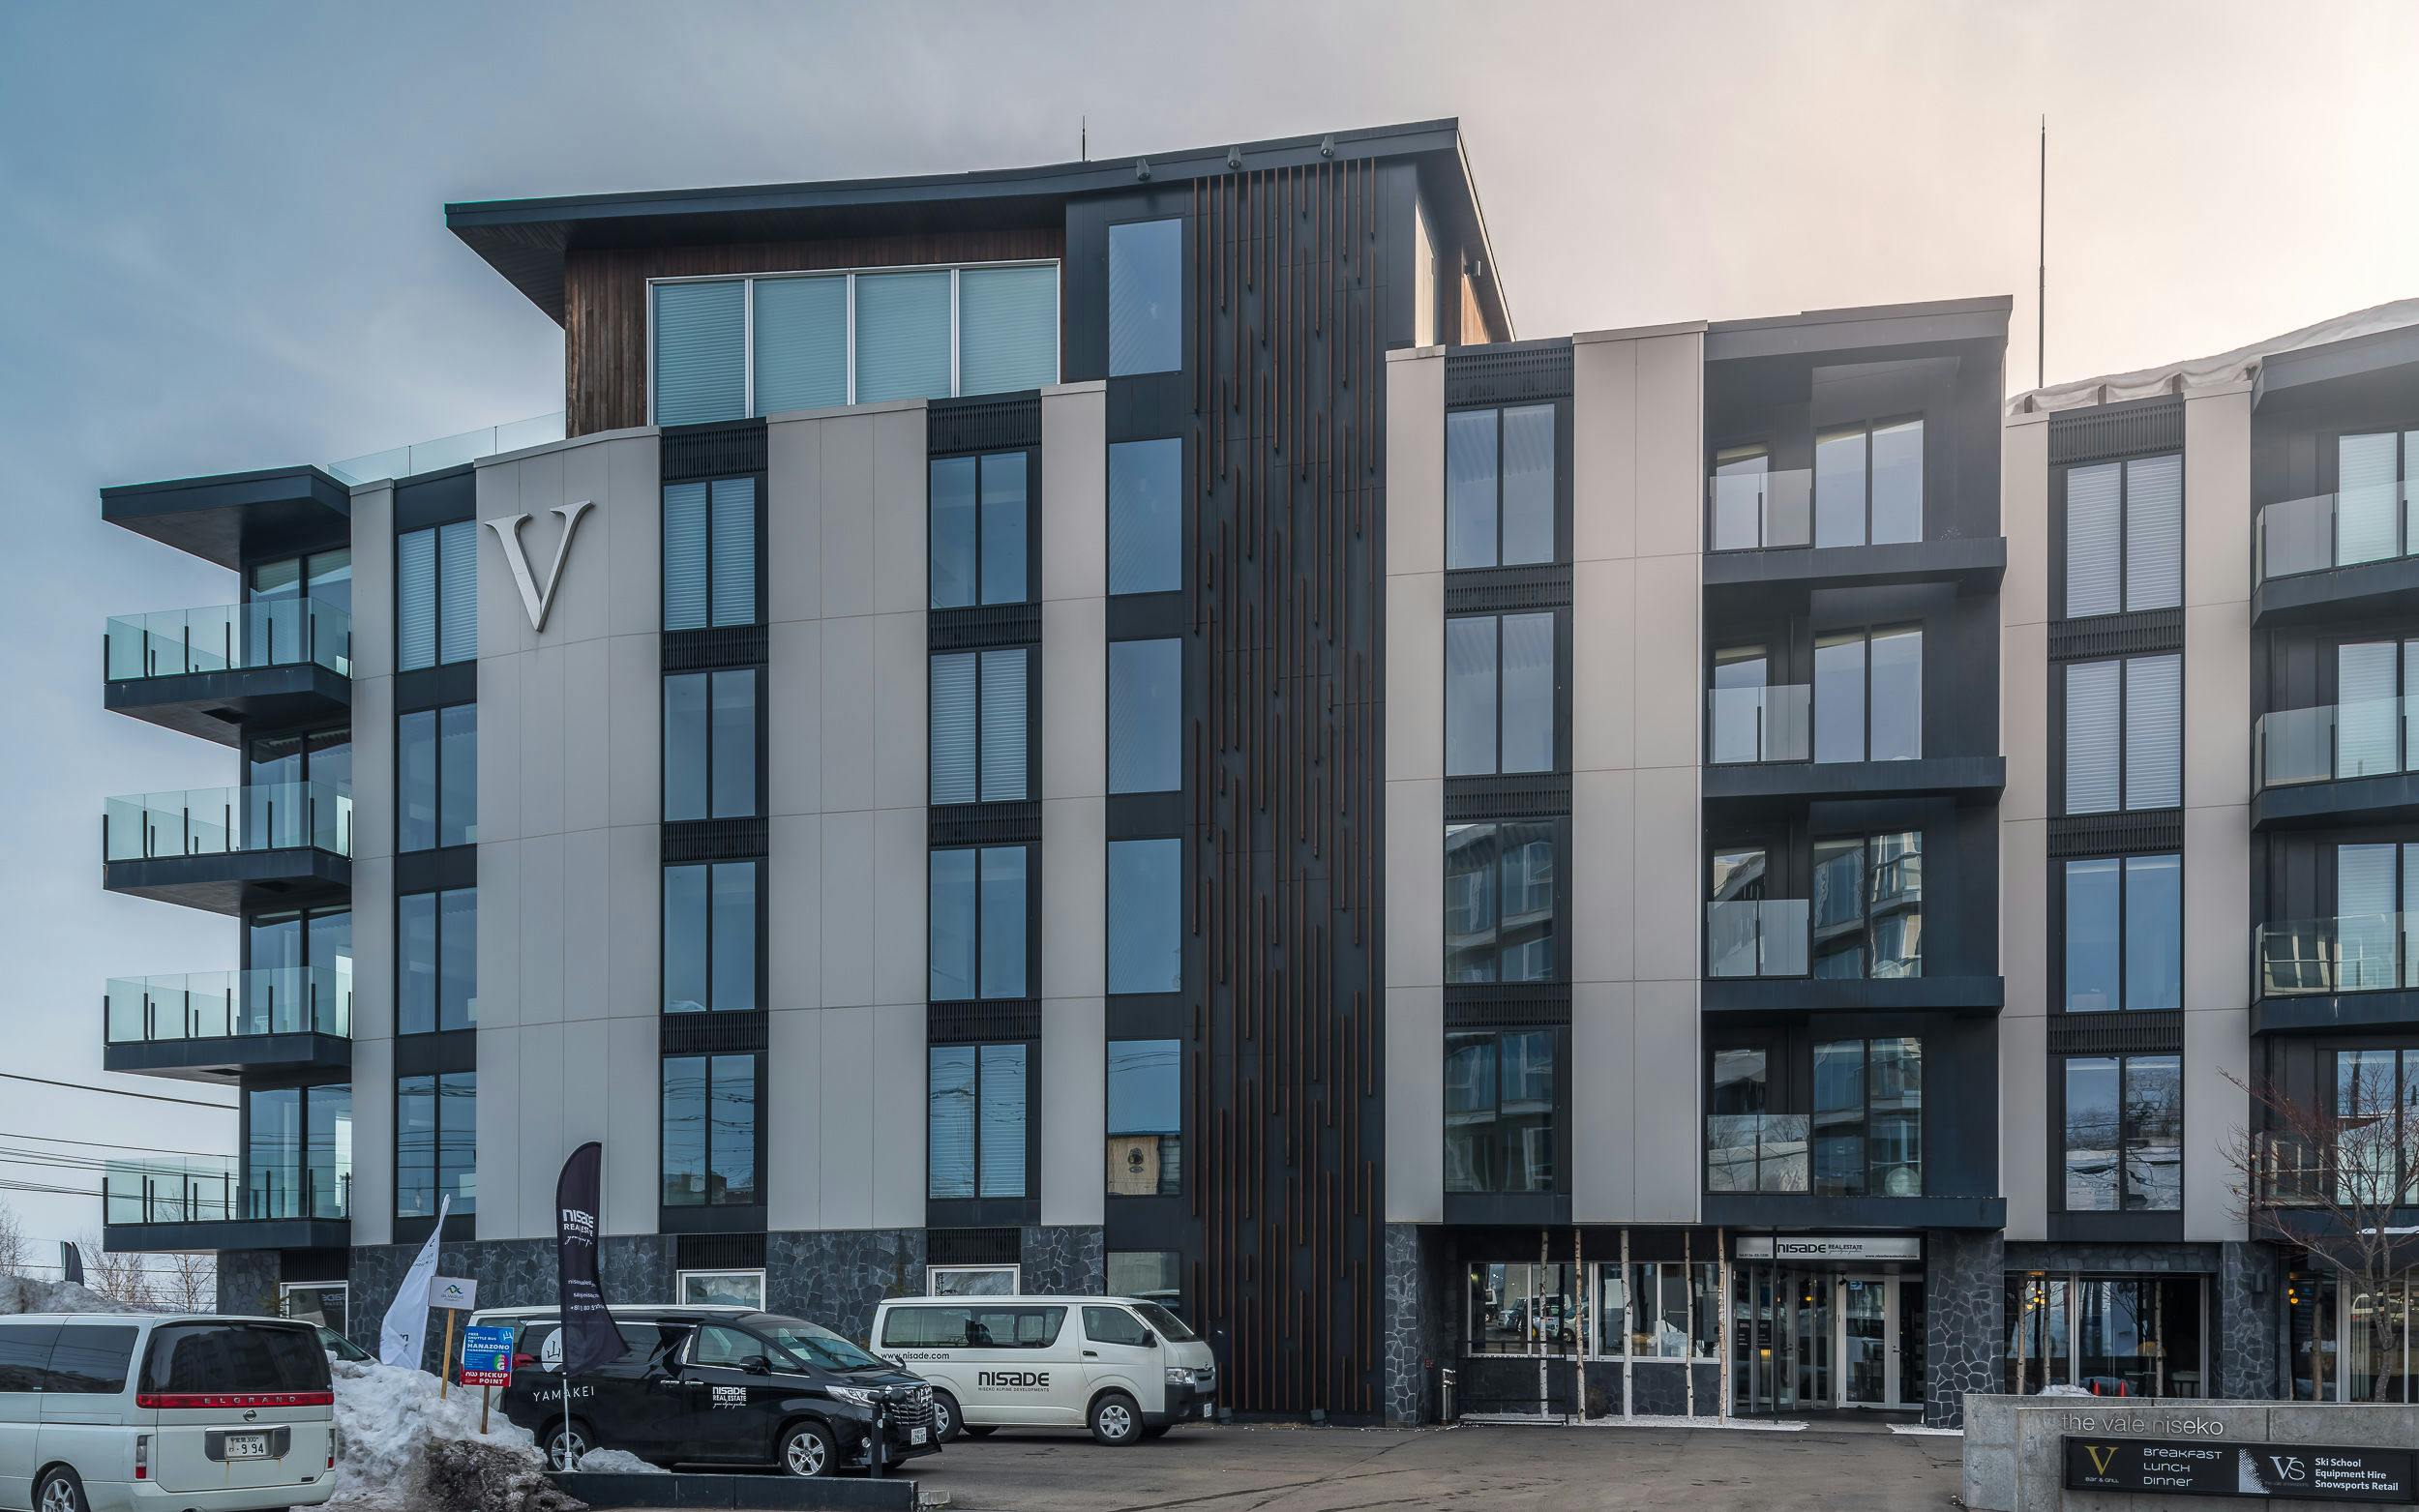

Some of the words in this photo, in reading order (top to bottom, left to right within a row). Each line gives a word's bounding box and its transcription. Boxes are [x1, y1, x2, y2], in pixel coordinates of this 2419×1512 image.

[484, 500, 596, 634] V
[532, 1385, 594, 1402] YAMAKEI
[2062, 1413, 2095, 1431] the
[2102, 1415, 2145, 1433] vale
[2152, 1416, 2224, 1435] niseko
[2084, 1445, 2119, 1476] V
[2314, 1457, 2329, 1467] Ski
[2330, 1458, 2361, 1468] School
[2314, 1468, 2366, 1479] Equipment
[2367, 1470, 2387, 1479] Hire
[2314, 1480, 2370, 1491] Snowsports
[2372, 1482, 2399, 1491] Retail
